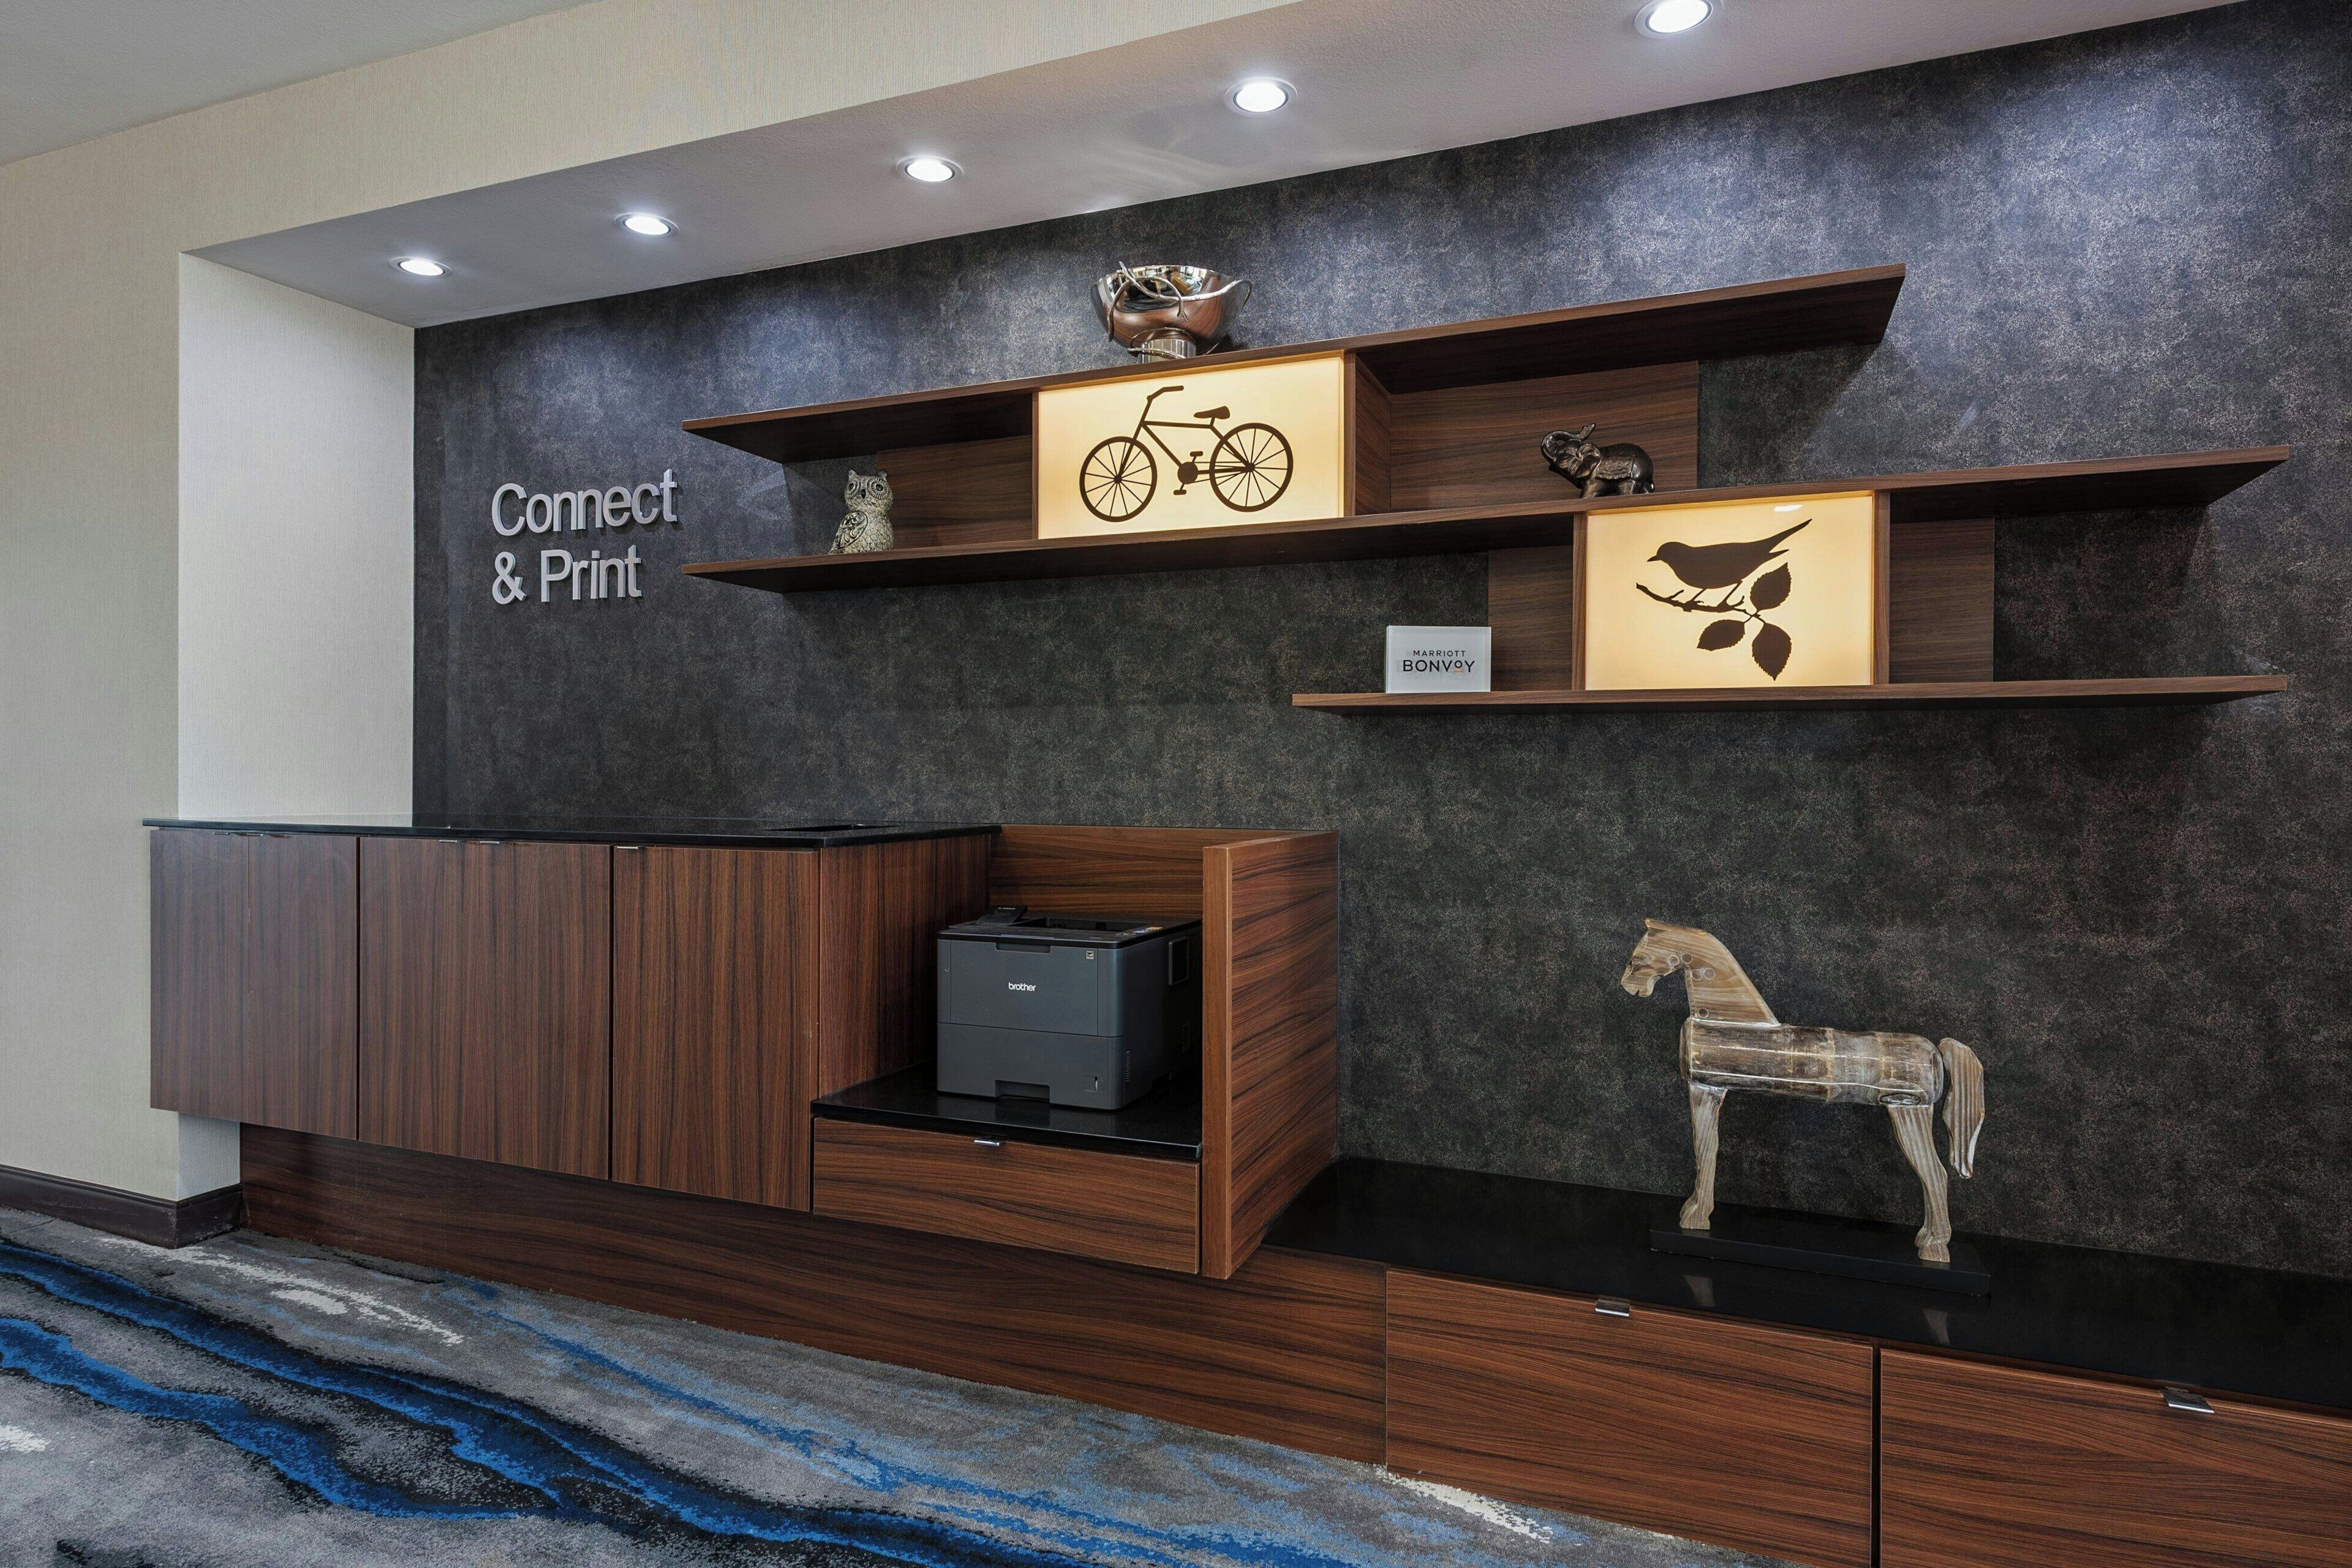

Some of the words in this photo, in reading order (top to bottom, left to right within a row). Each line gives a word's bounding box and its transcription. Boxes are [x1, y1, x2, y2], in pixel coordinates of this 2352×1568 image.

[492, 469, 677, 537] Connect
[492, 551, 527, 605] &
[541, 545, 642, 602] Print
[1403, 659, 1476, 673] BONVOY
[1008, 982, 1036, 992] brother
